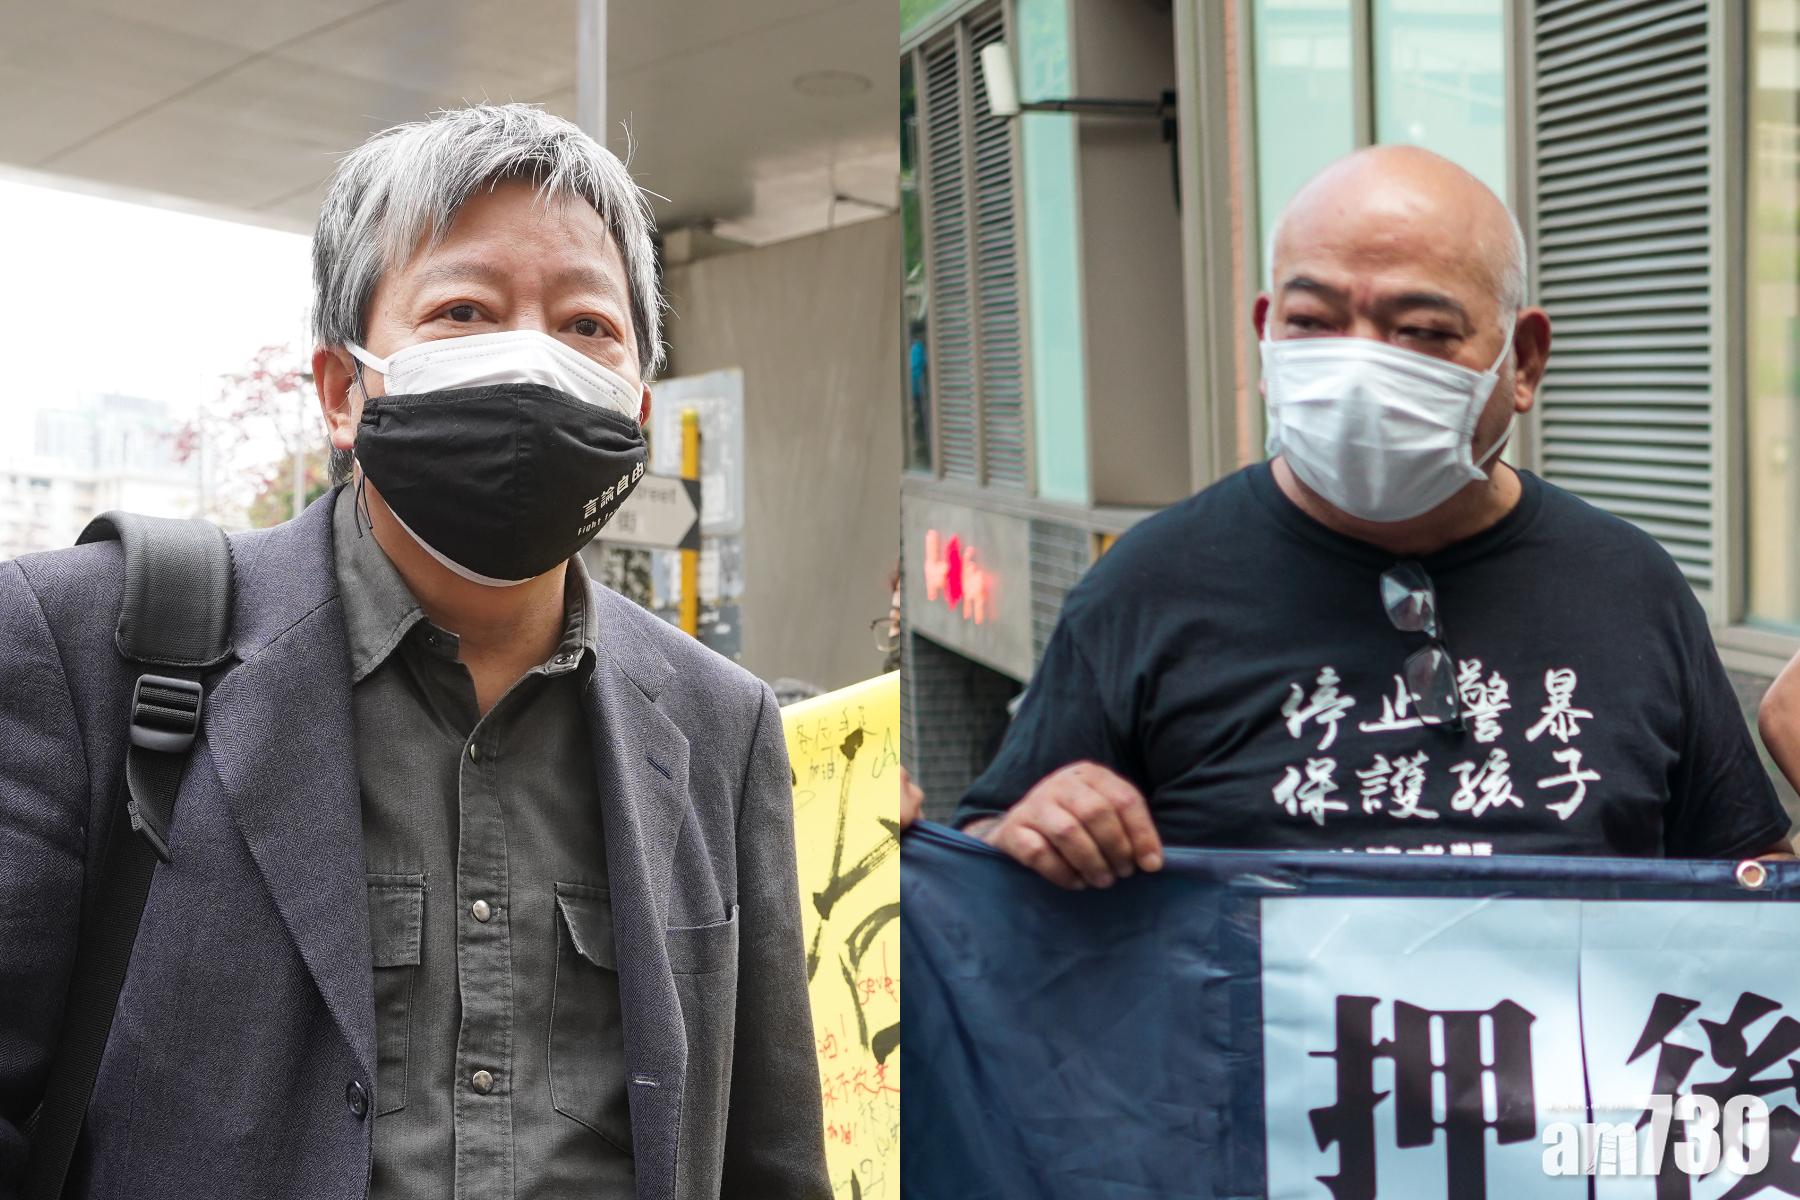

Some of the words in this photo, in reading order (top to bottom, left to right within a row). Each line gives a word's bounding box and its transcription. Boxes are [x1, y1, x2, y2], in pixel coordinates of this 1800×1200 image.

[582, 461, 644, 520] 言論自由
[1281, 656, 1595, 751] 停止警暴
[1272, 747, 1602, 826] 保護孩子
